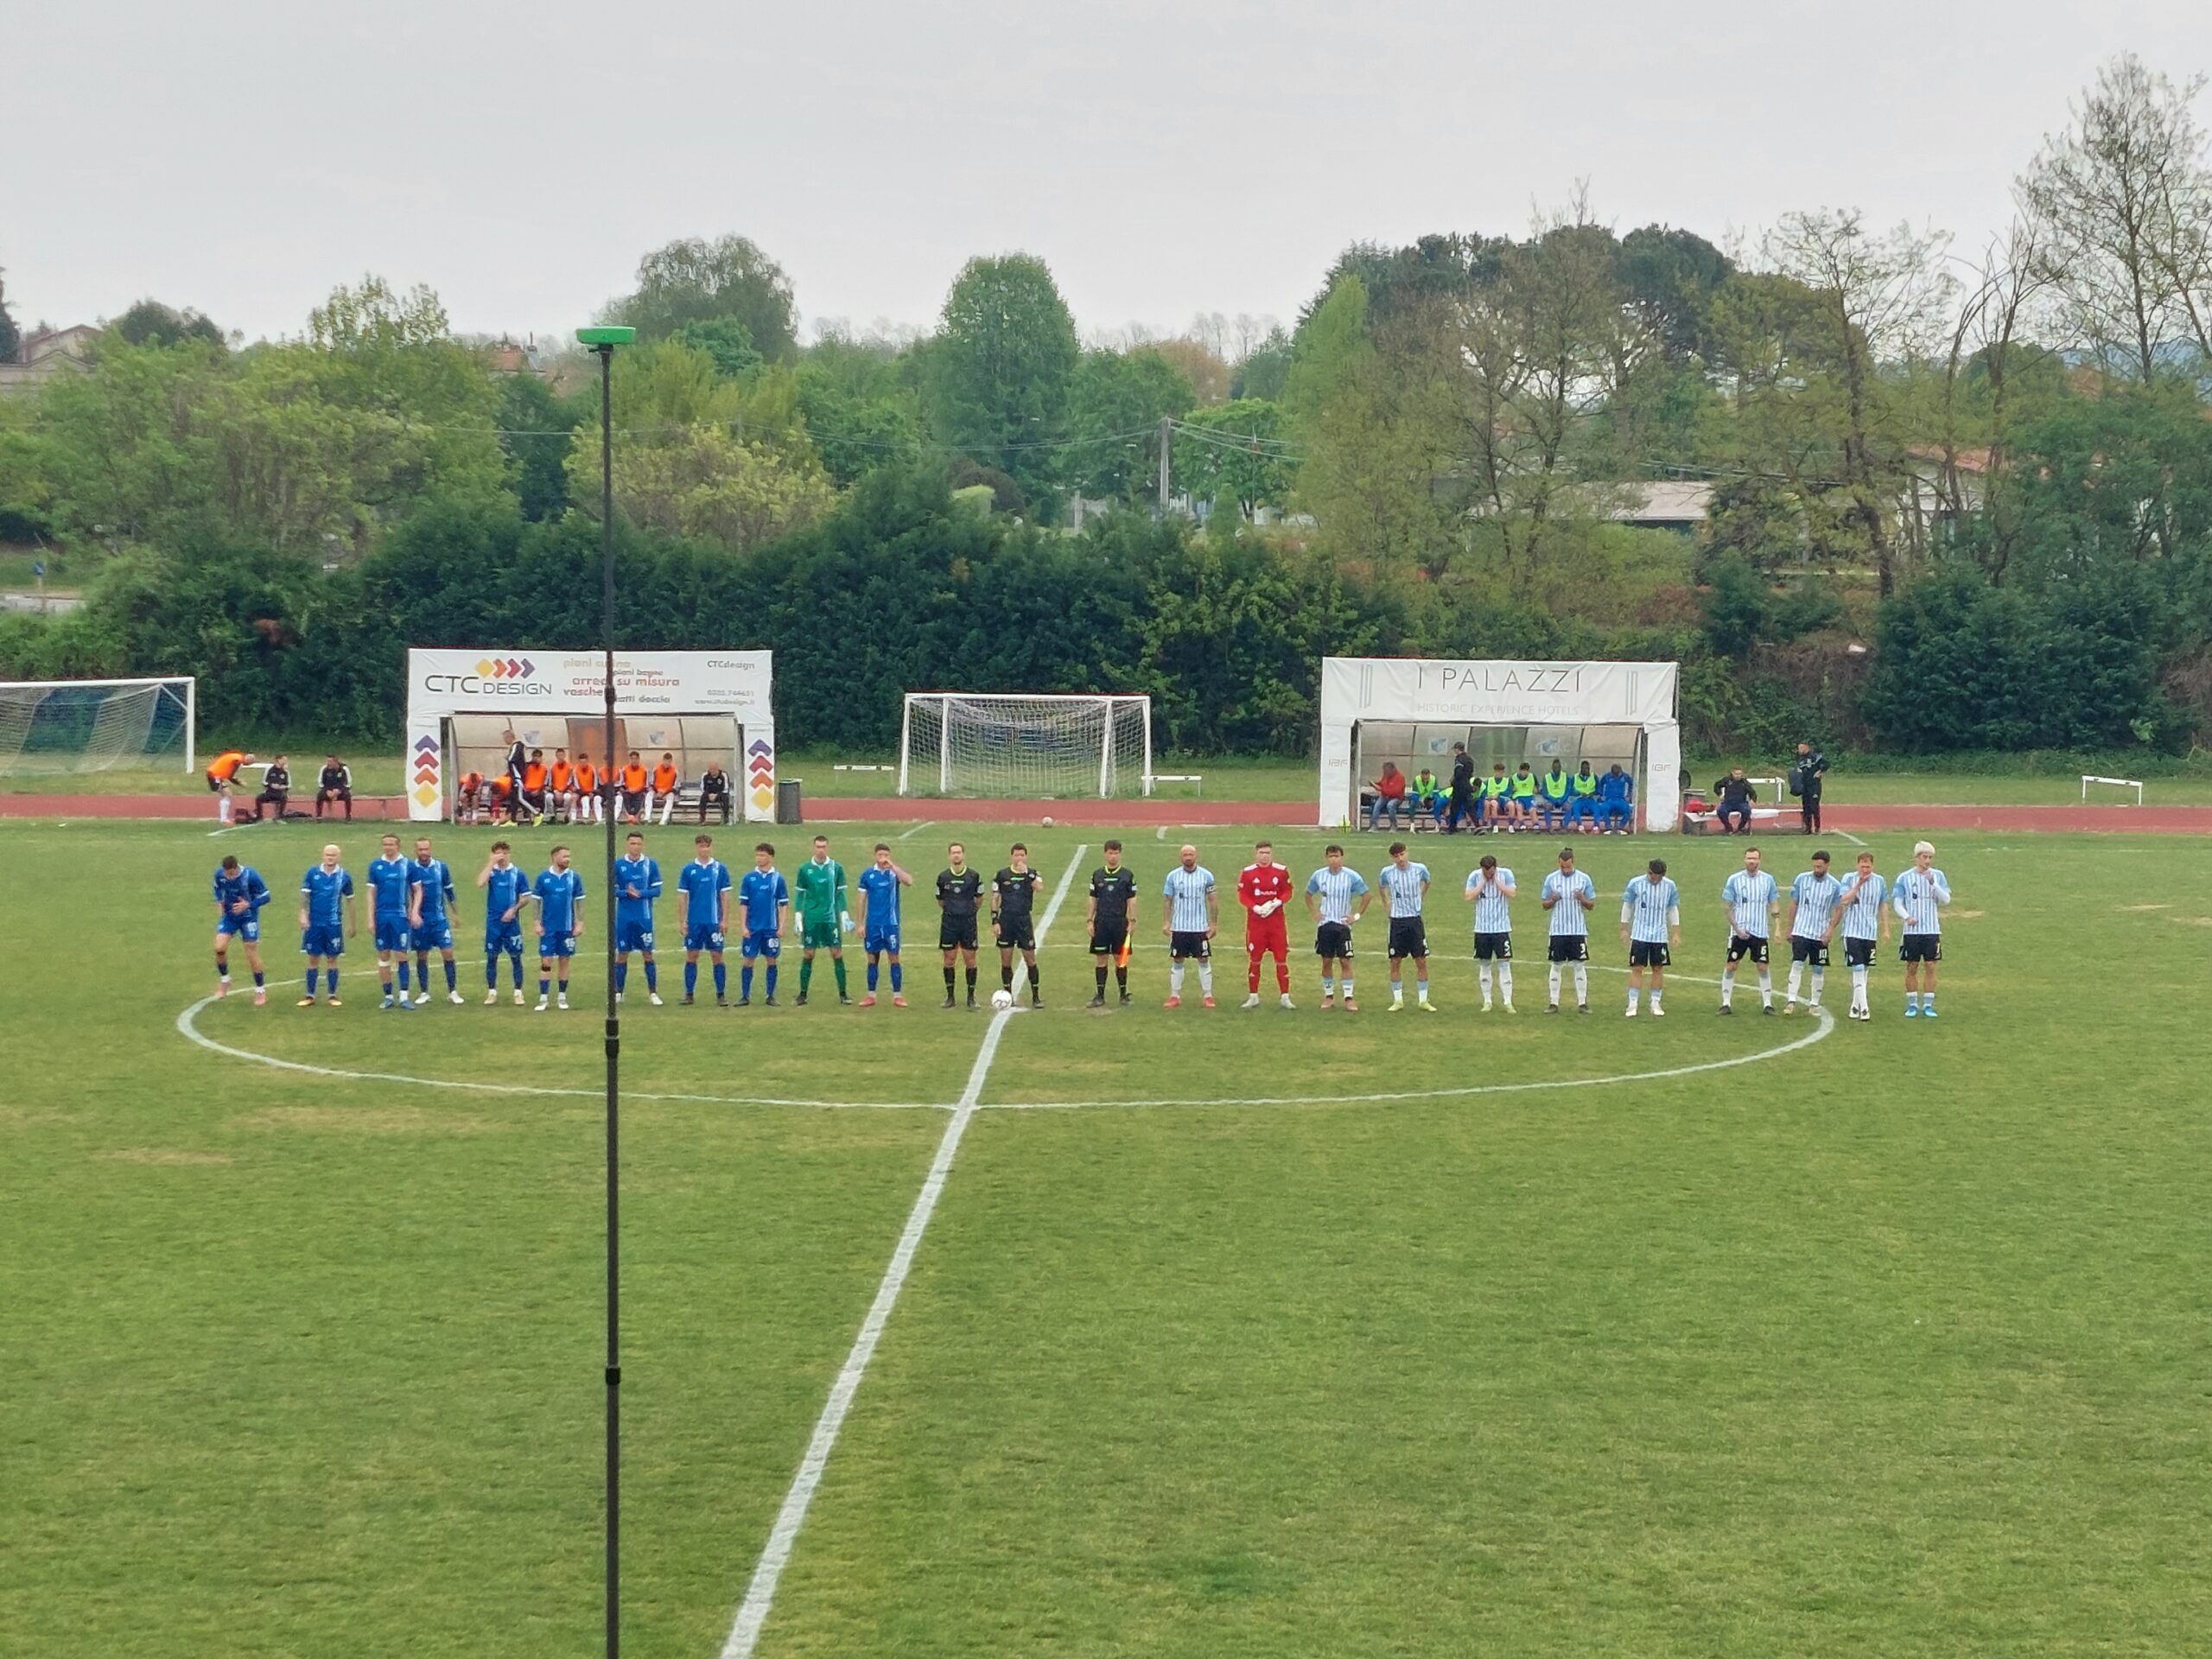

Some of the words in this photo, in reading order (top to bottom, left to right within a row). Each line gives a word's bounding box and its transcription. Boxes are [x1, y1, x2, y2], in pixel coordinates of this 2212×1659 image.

[617, 677, 631, 686] su
[635, 676, 680, 687] misura
[1417, 666, 1422, 690] I
[1442, 667, 1580, 693] PALAZZI
[1417, 702, 1467, 713] HISTORIC
[1471, 704, 1535, 715] EXPERIENCE
[1538, 705, 1580, 716] HOTELS
